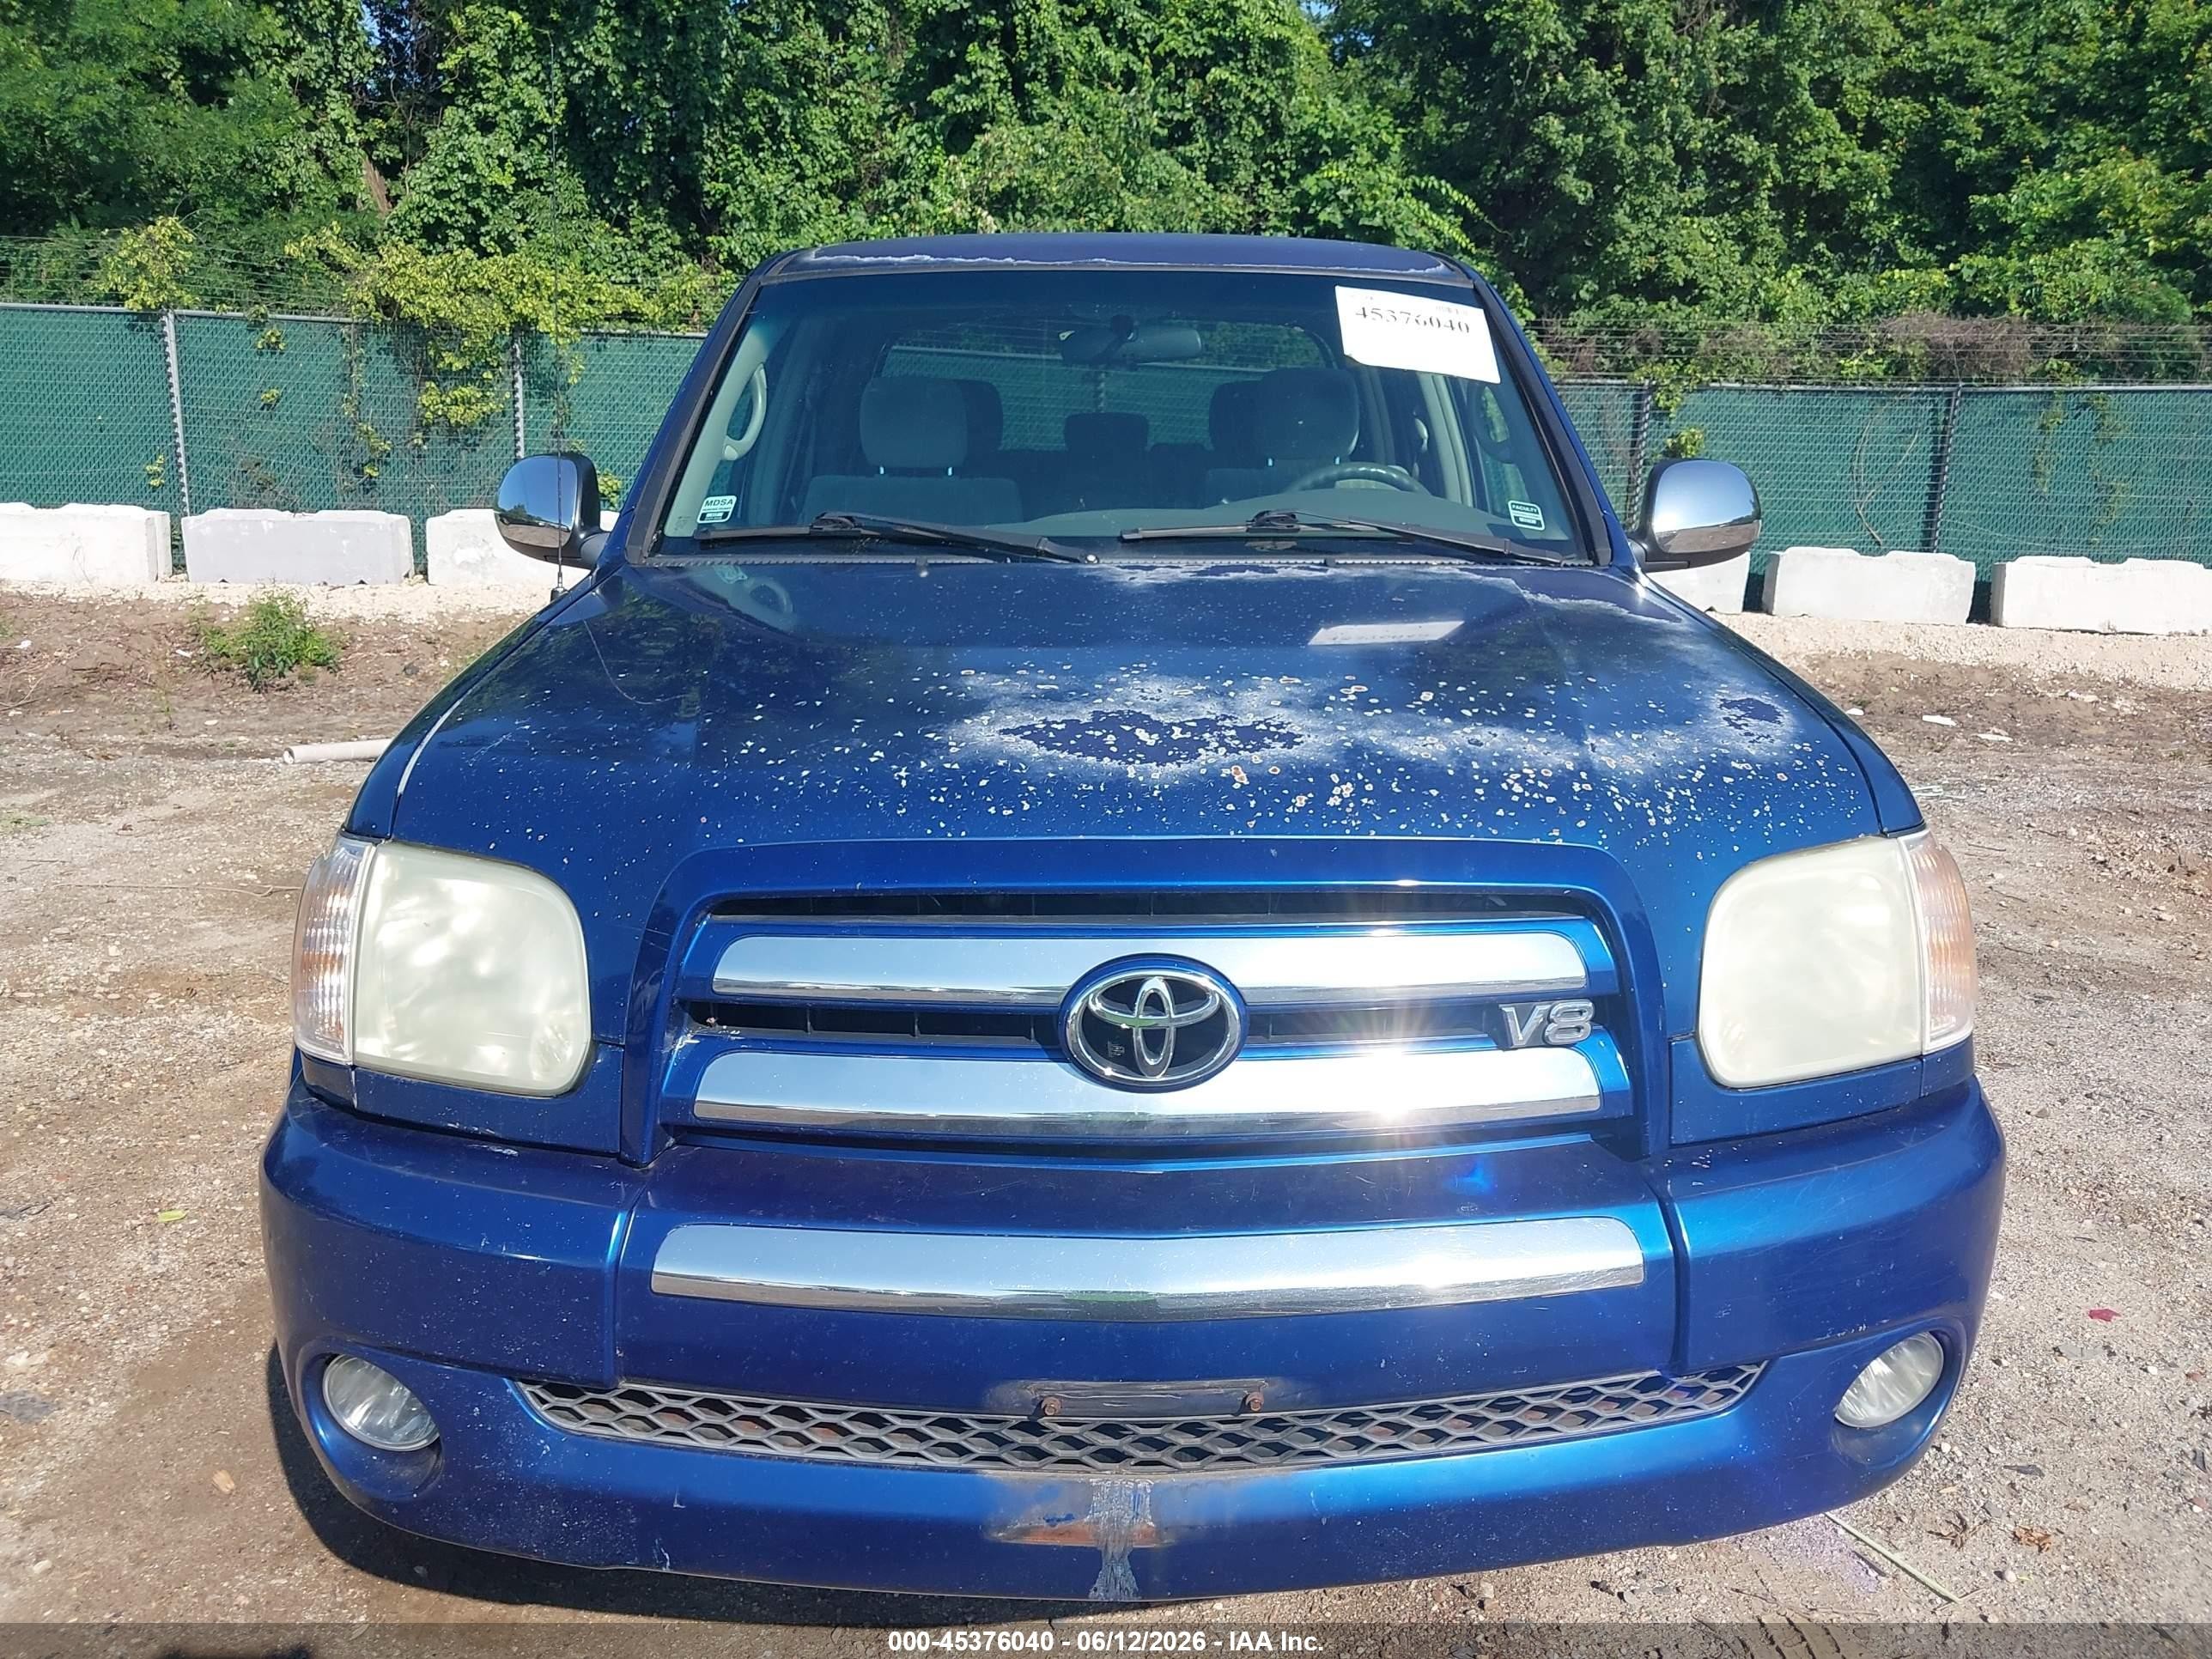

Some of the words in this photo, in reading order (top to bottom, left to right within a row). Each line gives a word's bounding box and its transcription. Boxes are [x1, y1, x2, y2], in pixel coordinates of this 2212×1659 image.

[1355, 307, 1470, 334] 45376040
[704, 498, 733, 507] MDSA
[1499, 999, 1595, 1048] V8
